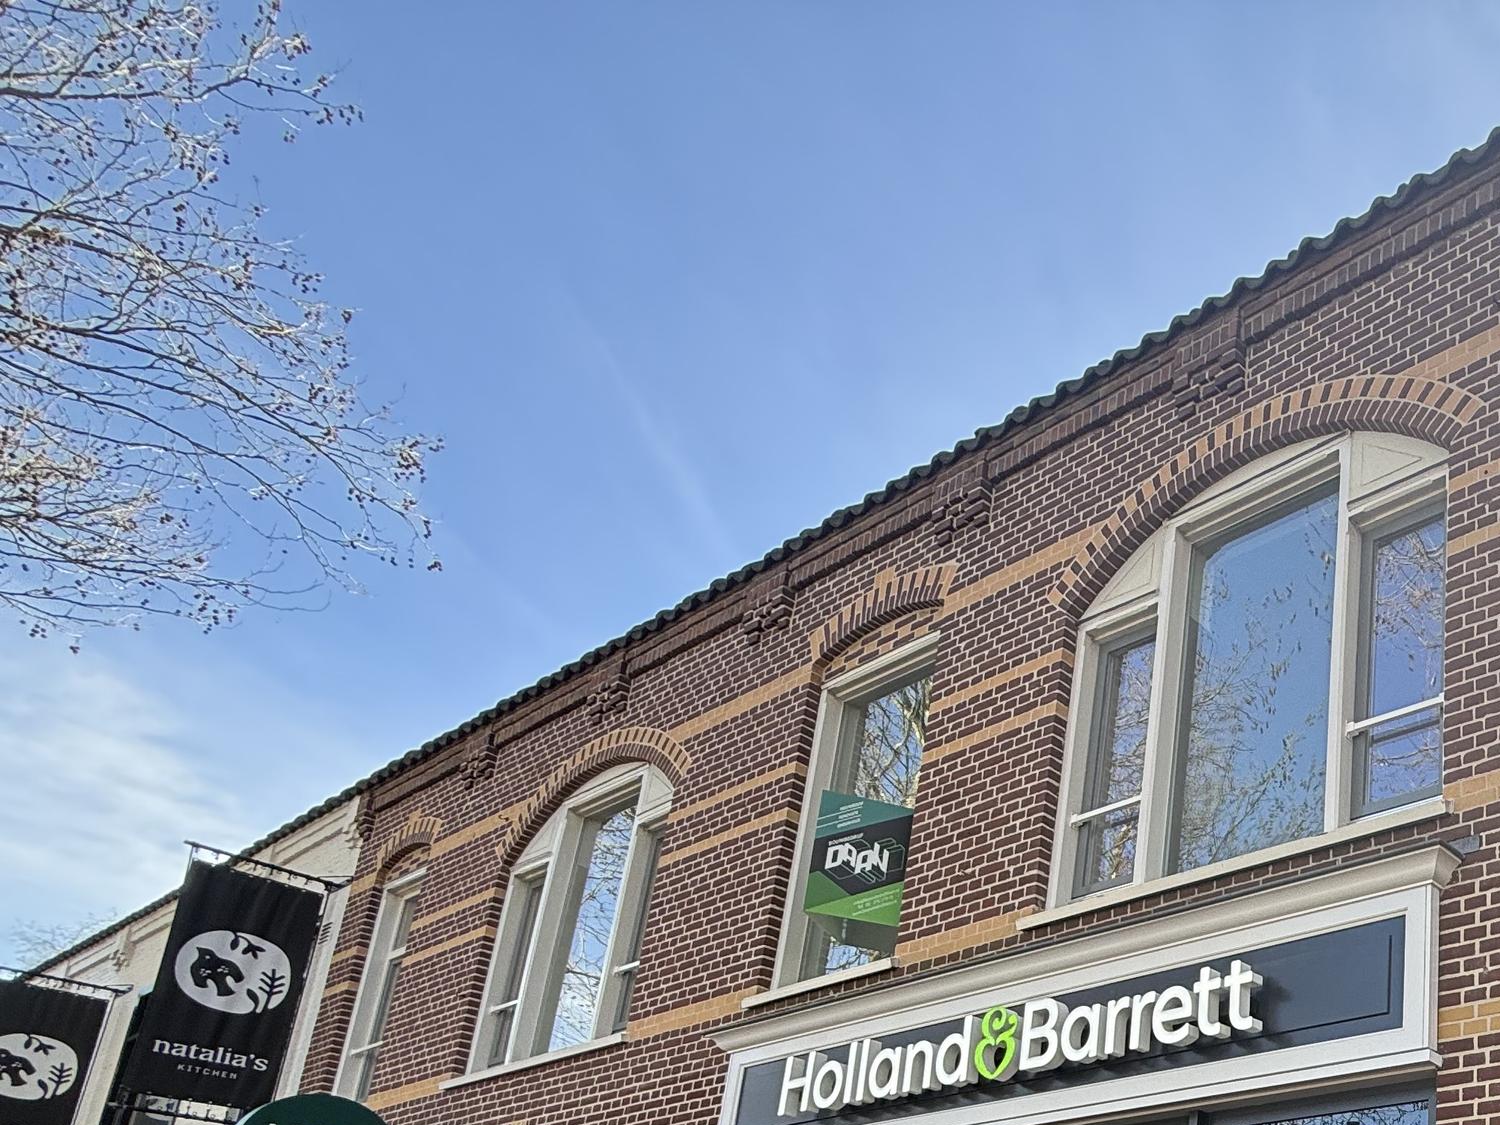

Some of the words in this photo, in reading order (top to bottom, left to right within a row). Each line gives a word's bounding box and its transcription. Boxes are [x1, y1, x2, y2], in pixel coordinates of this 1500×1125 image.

[824, 841, 890, 875] DAAN
[152, 1039, 269, 1072] natalia's
[177, 1063, 237, 1080] KITCHEN
